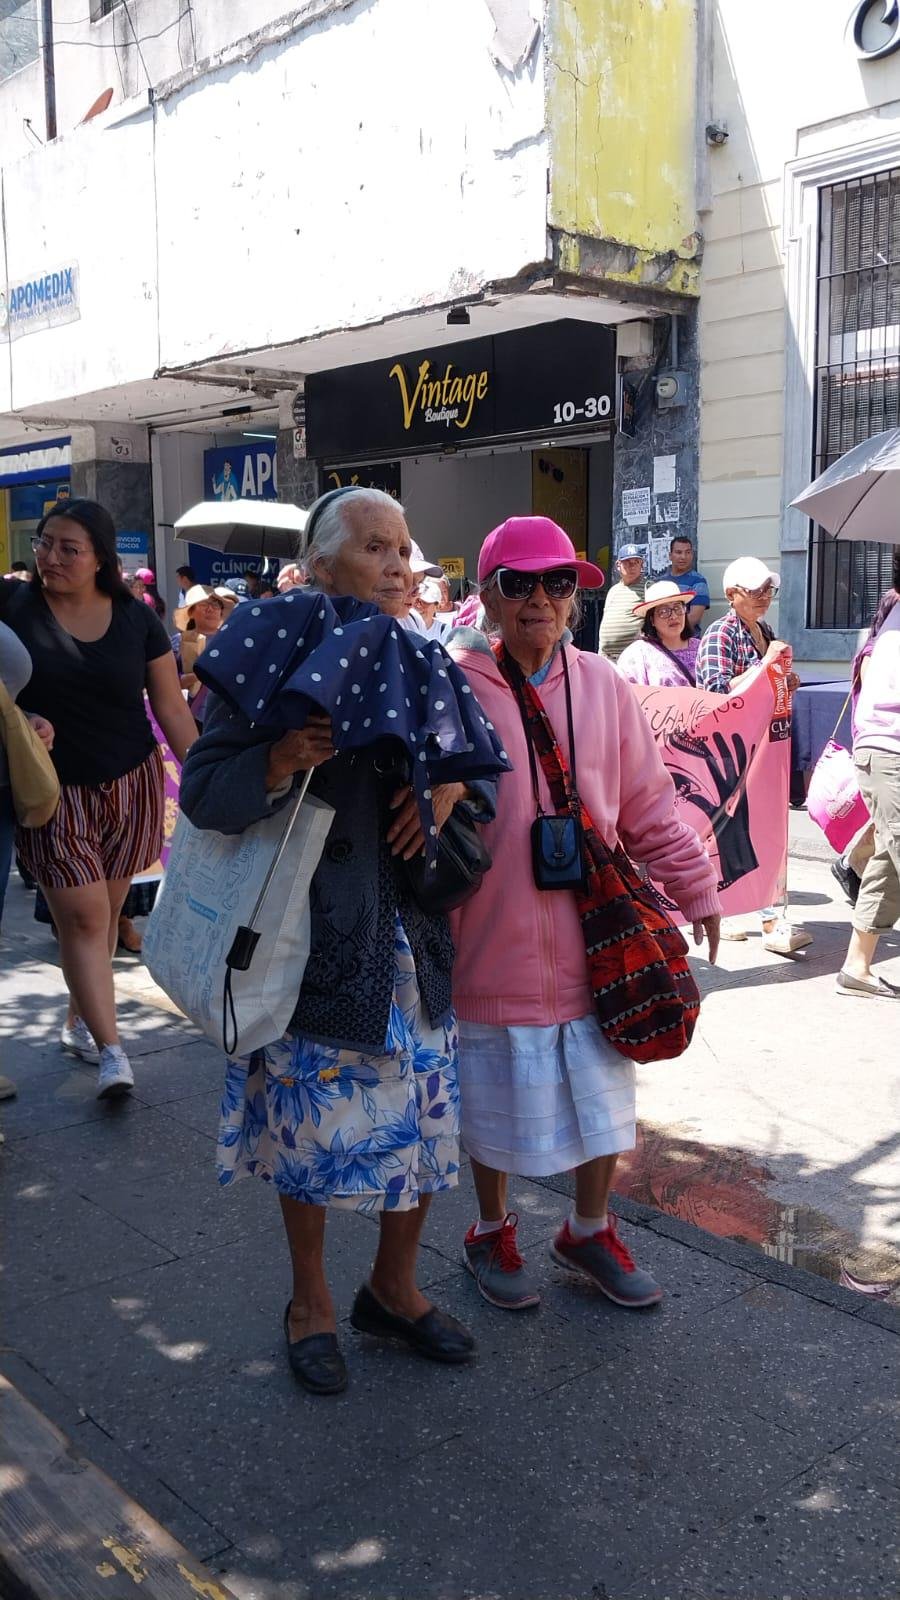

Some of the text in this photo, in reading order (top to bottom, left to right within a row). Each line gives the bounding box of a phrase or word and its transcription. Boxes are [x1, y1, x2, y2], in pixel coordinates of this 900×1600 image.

[9, 267, 73, 313] APOMEDIX
[389, 360, 488, 429] Vintage
[553, 394, 611, 424] 10-30
[425, 407, 459, 428] Boutique
